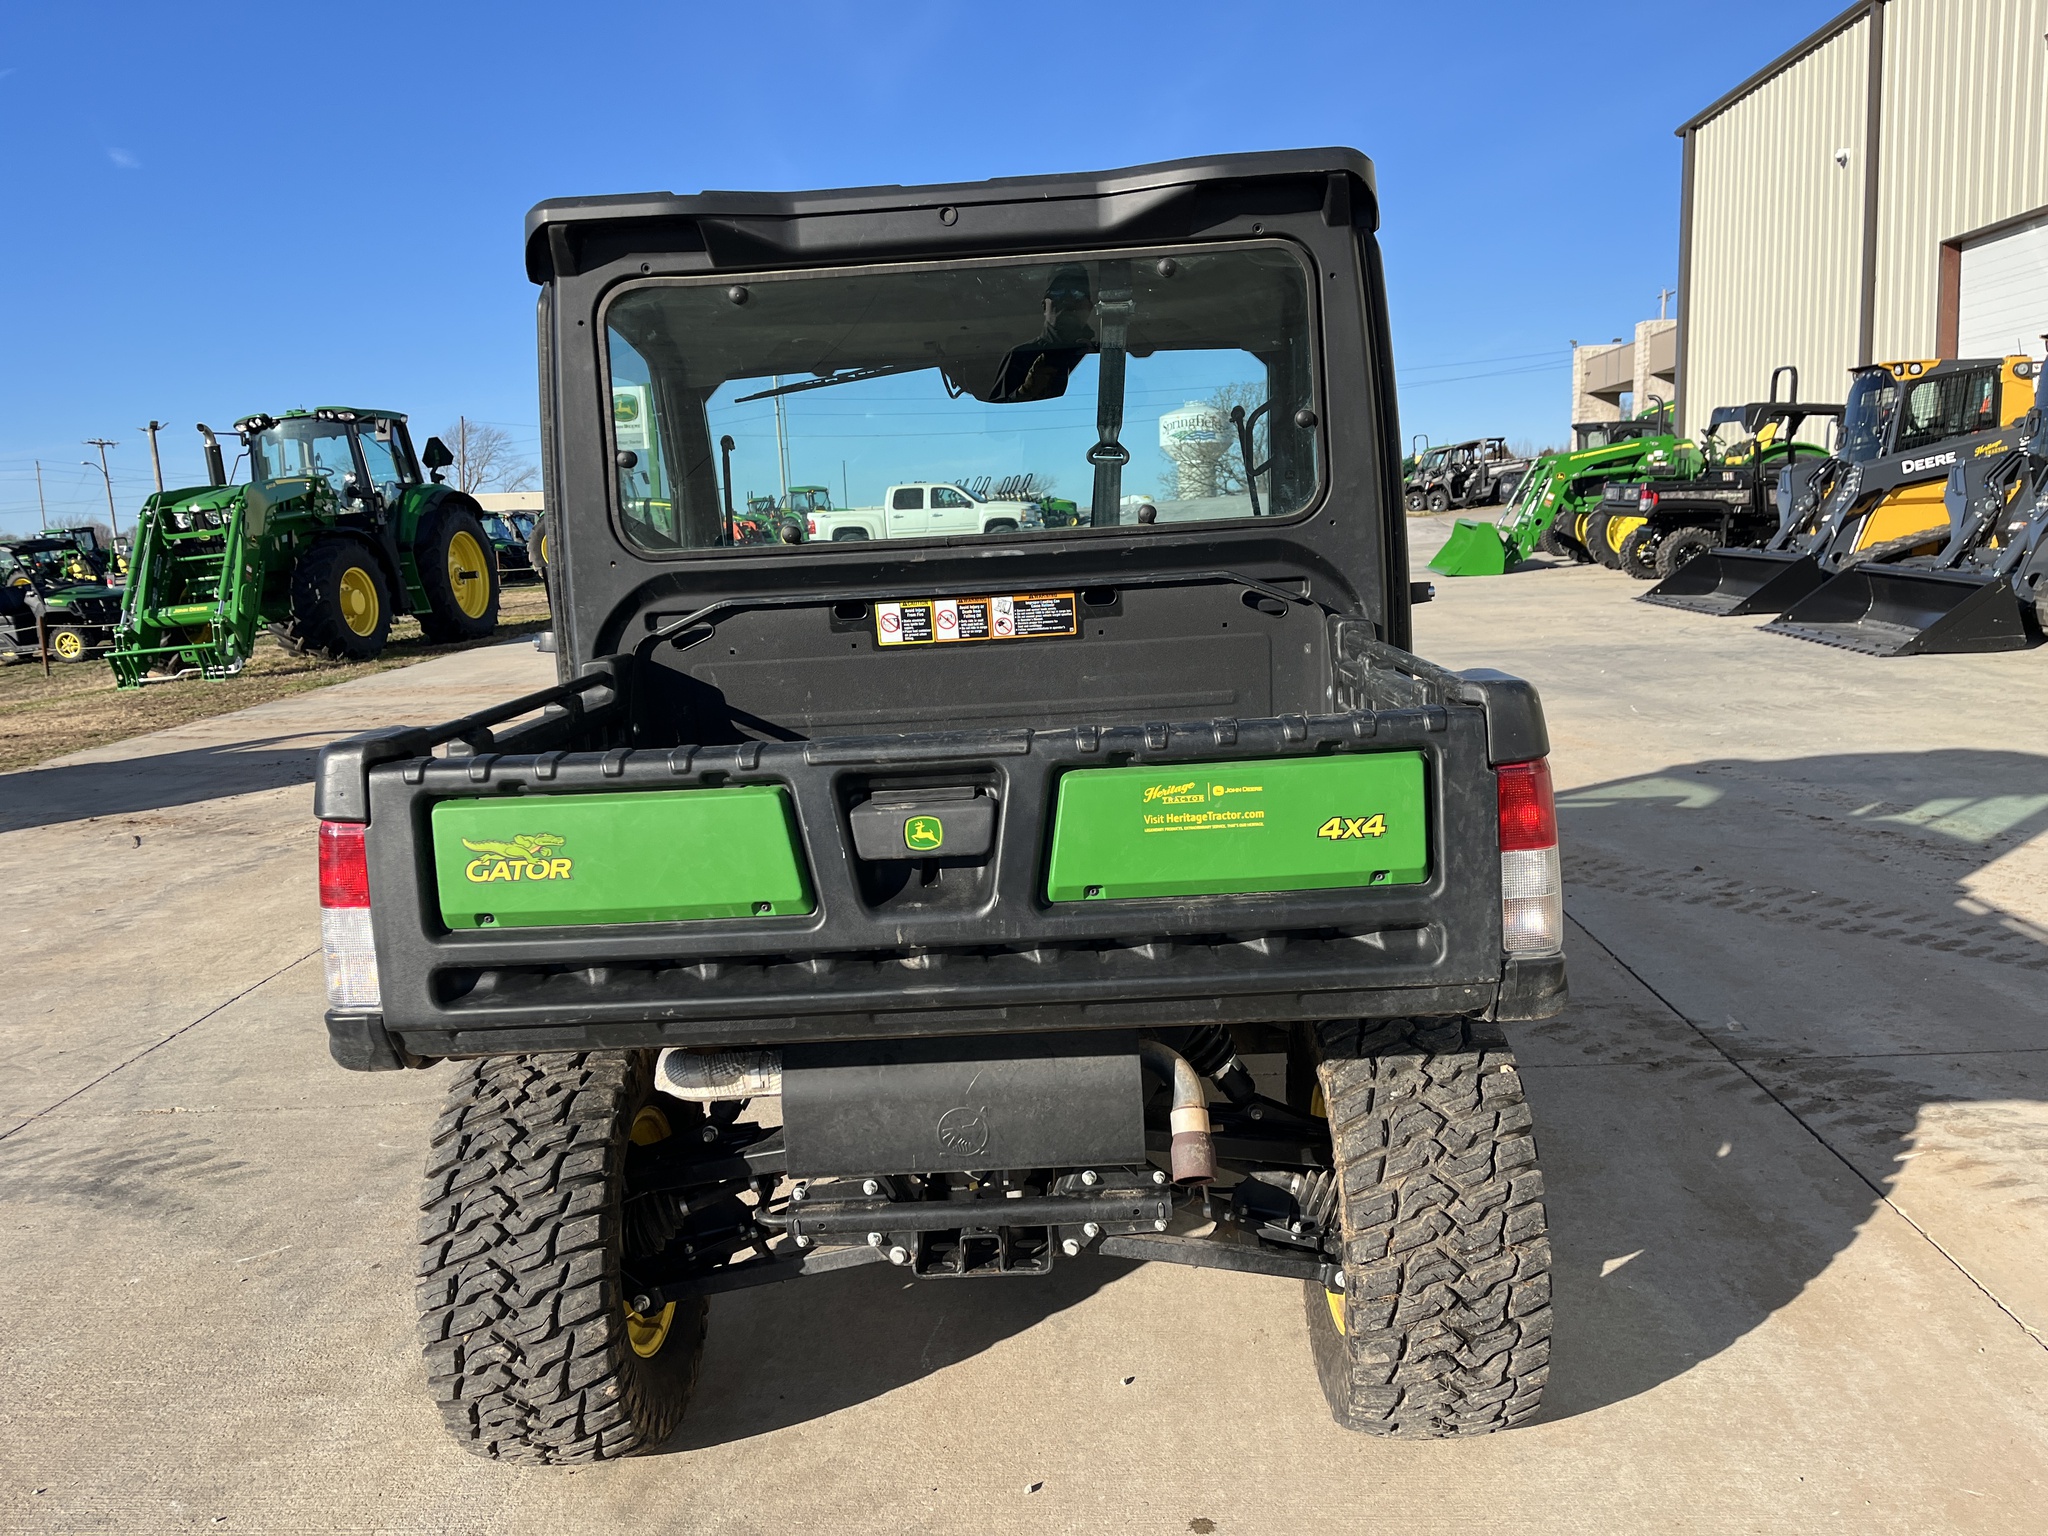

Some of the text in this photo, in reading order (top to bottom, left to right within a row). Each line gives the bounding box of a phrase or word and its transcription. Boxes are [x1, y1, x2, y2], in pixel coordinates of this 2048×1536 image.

[1901, 451, 1957, 475] DEERE
[1143, 781, 1196, 803] Heritage
[1162, 794, 1205, 804] TRACTOR
[1143, 810, 1265, 825] Visit HeritageTractor.com
[1317, 812, 1389, 840] 4x4
[465, 857, 574, 883] GATOR
